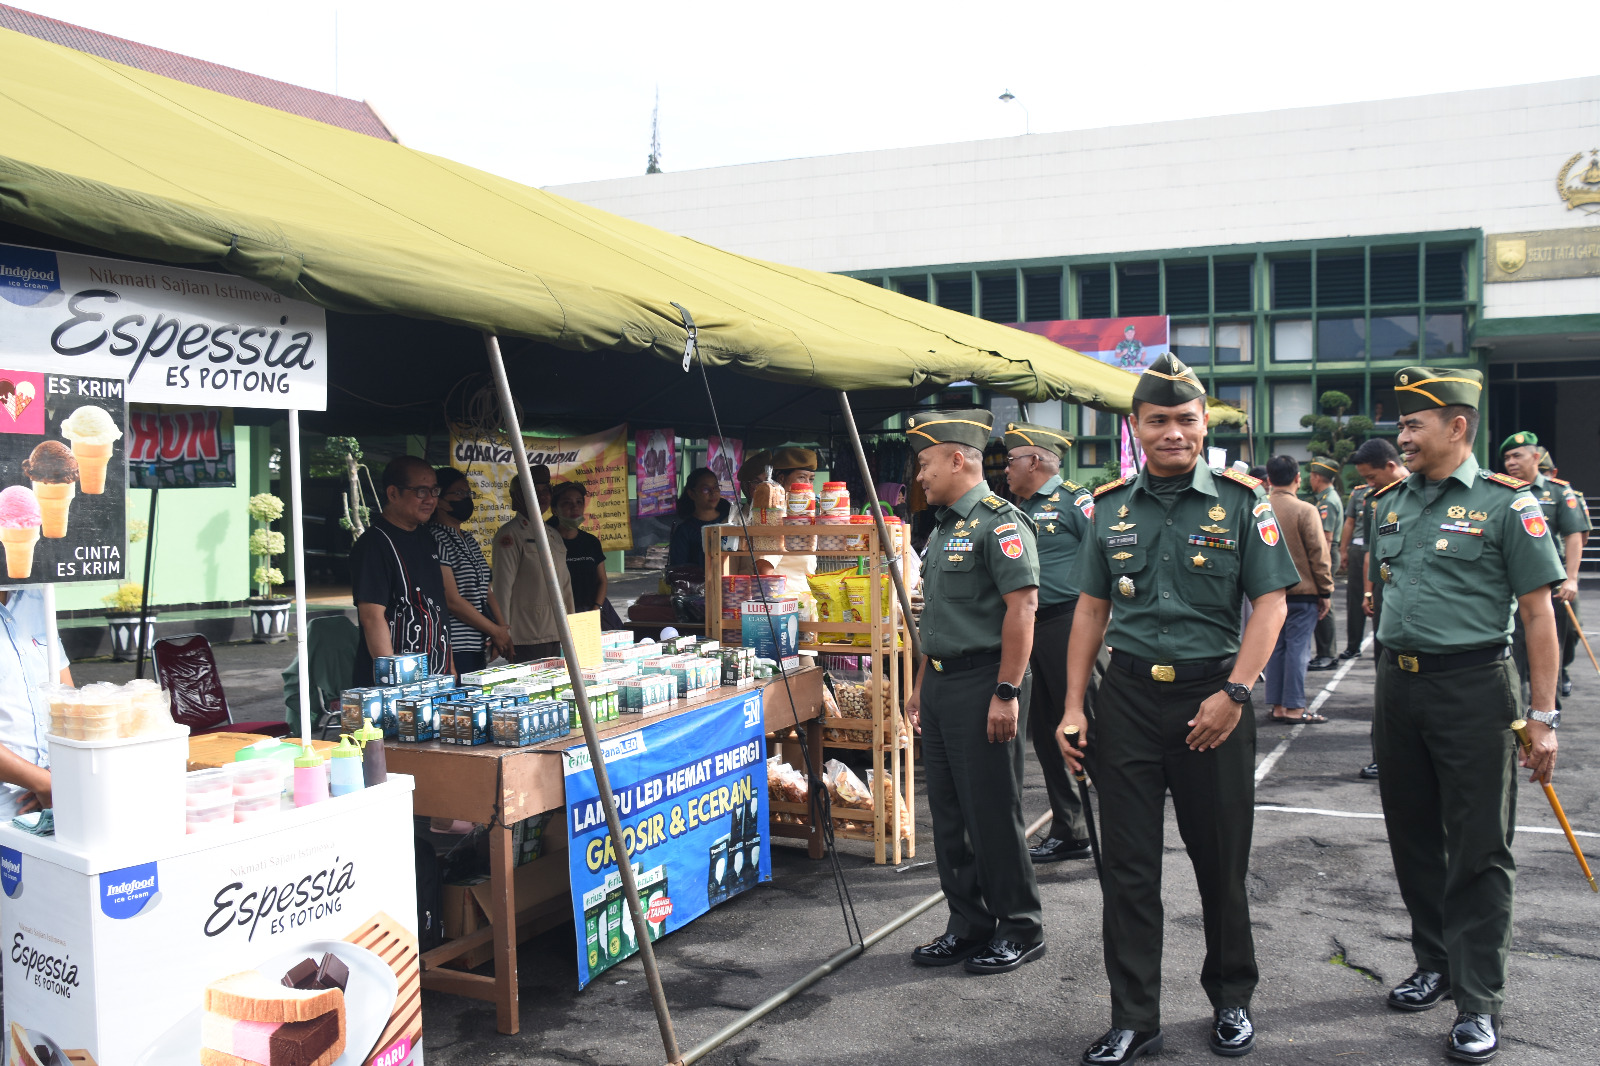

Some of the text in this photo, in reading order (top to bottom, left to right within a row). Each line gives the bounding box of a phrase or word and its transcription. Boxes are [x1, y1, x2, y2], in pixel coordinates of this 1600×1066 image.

[0, 263, 55, 282] Indofood
[89, 266, 282, 304] Nikmati Sajian Istimewa
[51, 289, 316, 385] Espessia
[48, 377, 122, 399] ES KRIM
[166, 366, 290, 394] ES POTONG
[74, 546, 121, 560] CINTA
[57, 561, 121, 577] ES KRIM
[636, 780, 663, 809] LED
[666, 765, 713, 797] HEMAT
[715, 740, 760, 775] ENERGI
[586, 774, 753, 871] GROSIR & ECERAN
[230, 842, 336, 877] Nikmati Sajian Istimewa
[107, 876, 155, 897] Indofood
[204, 856, 356, 942] Espessia
[270, 900, 343, 936] ES POTONG
[650, 905, 673, 918] TAHUN
[587, 920, 595, 931] 15
[11, 932, 80, 988] Espessia
[34, 974, 71, 999] ES POTONG
[377, 1044, 405, 1066] BARU
